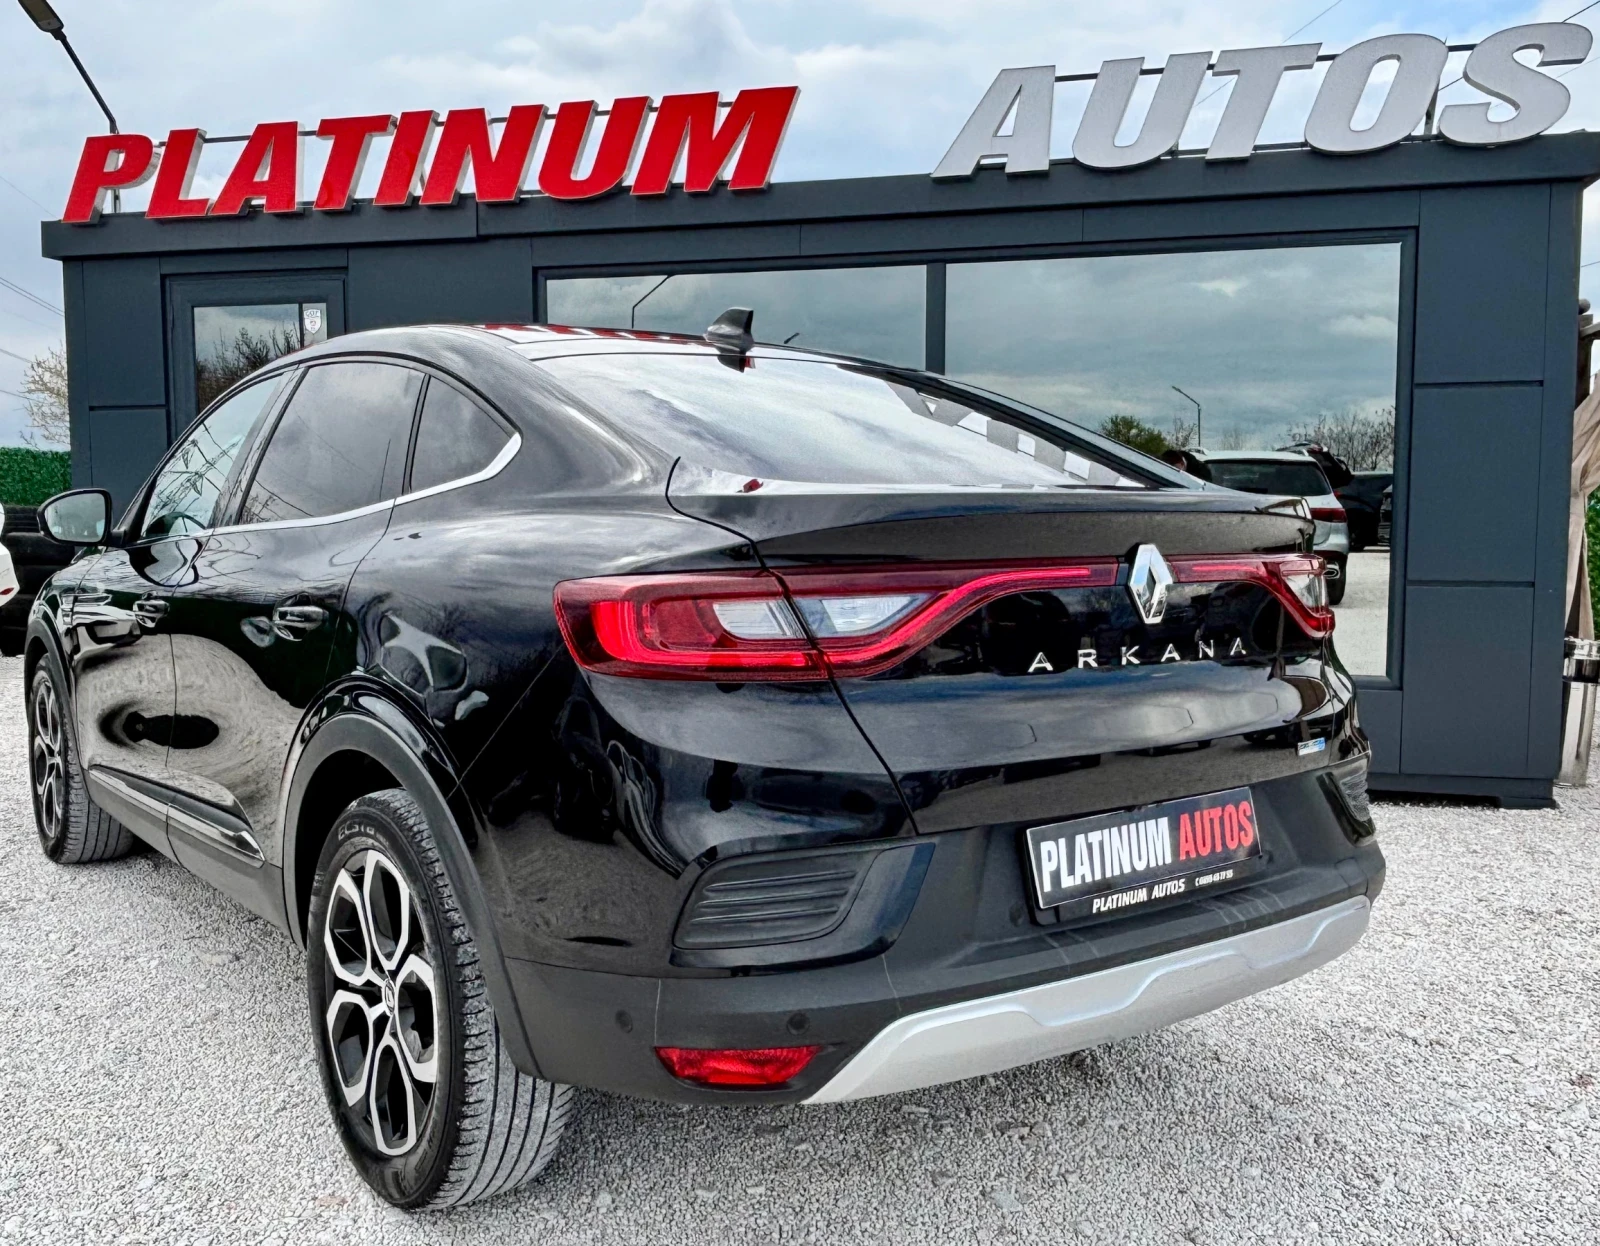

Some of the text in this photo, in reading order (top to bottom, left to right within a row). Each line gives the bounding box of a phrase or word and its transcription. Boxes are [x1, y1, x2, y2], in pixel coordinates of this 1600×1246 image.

[62, 22, 1594, 223] PLATINUM AUTOS
[1027, 637, 1247, 673] ARKANA
[1040, 801, 1253, 892] PLATINUM AUTOS
[1092, 887, 1148, 914] PLATINUM
[1151, 878, 1186, 899] AUTOS
